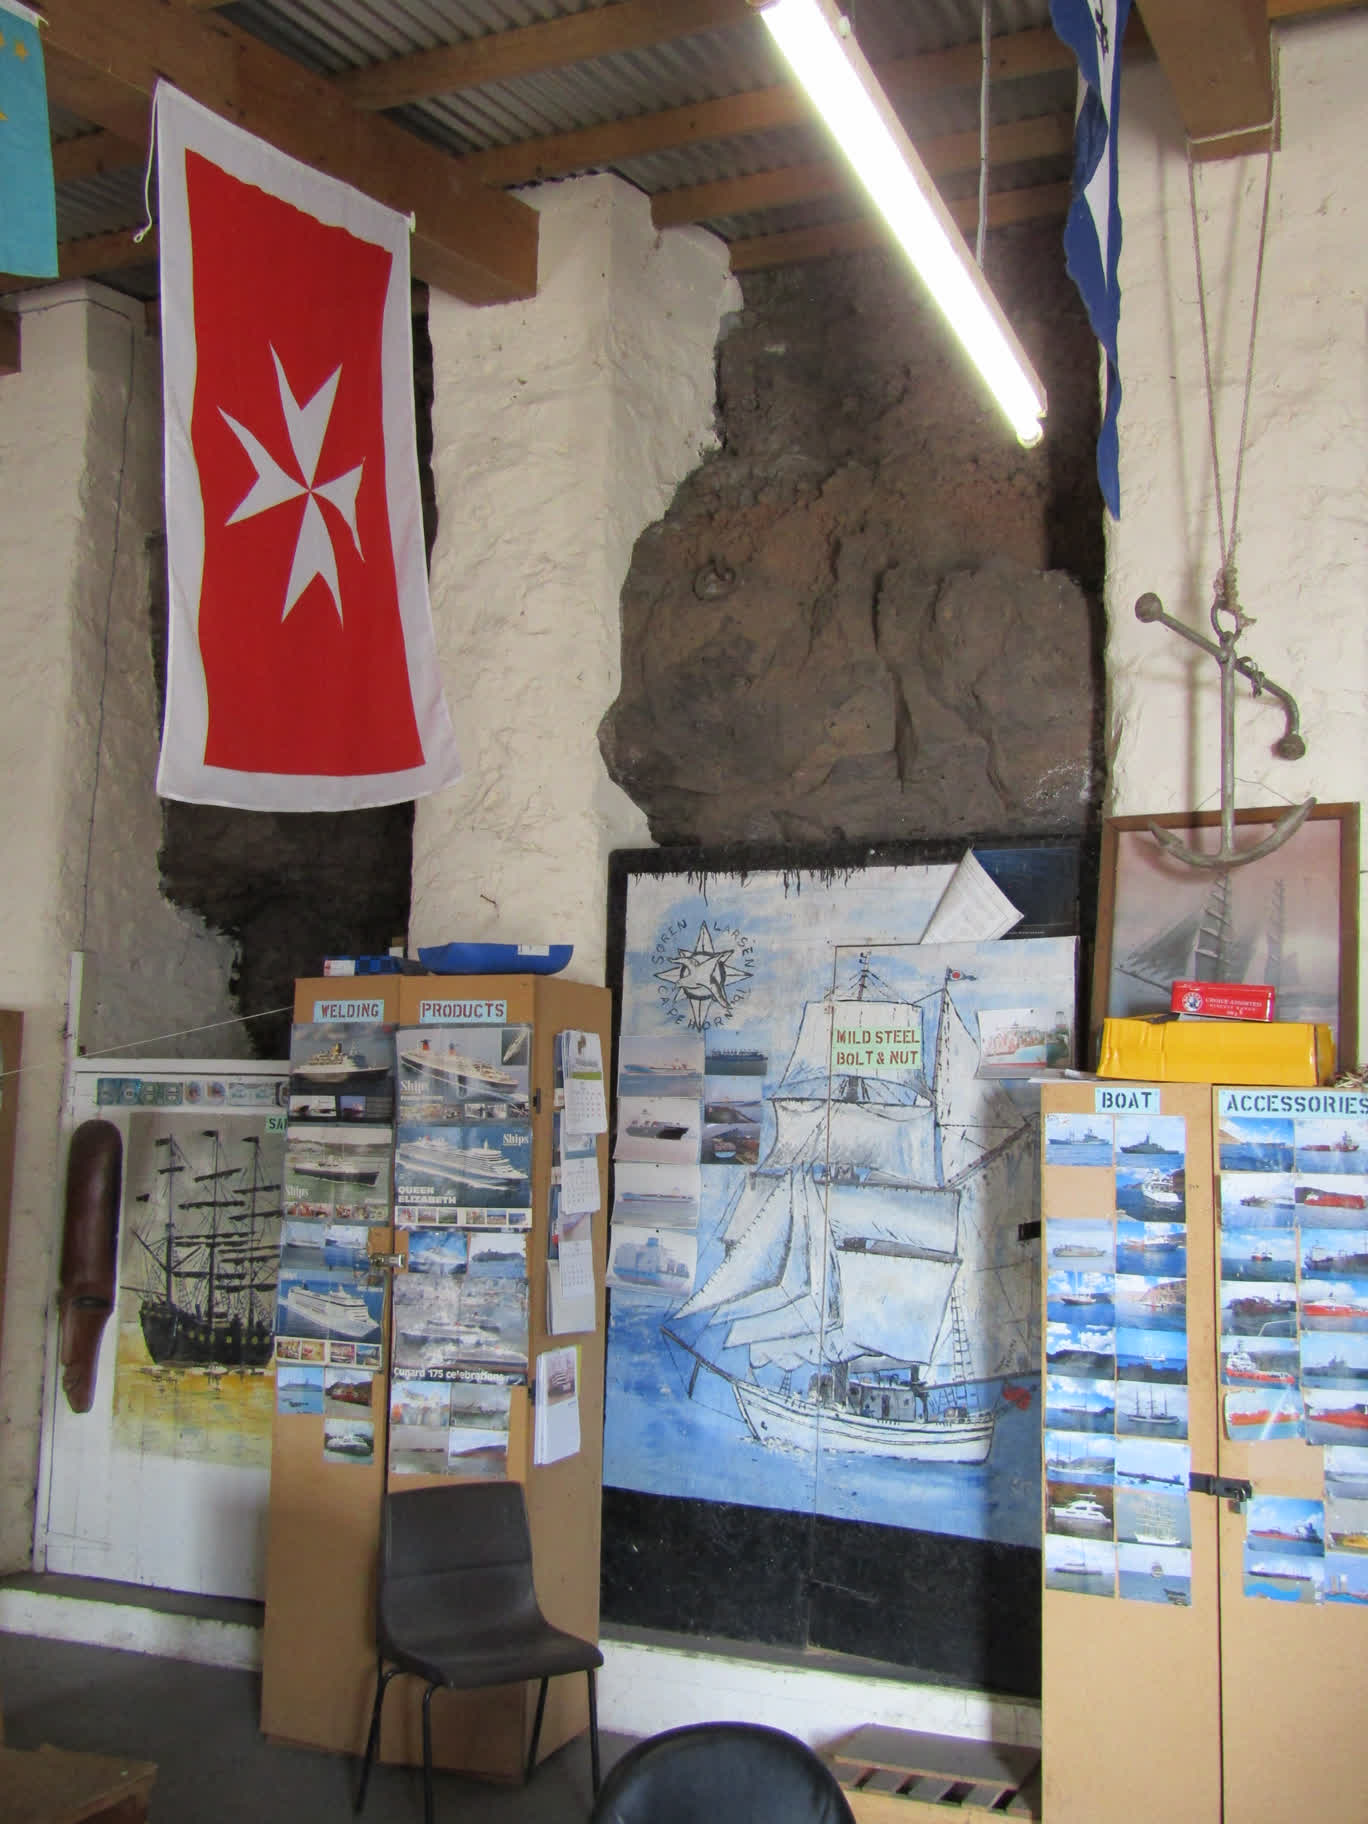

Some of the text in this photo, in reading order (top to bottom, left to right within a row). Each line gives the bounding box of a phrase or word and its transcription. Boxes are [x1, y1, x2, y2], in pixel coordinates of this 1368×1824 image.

[714, 921, 755, 969] LARSEN
[321, 1002, 379, 1018] WELDING
[421, 1001, 505, 1018] PRODUCTS
[658, 985, 685, 1025] CAPE
[688, 1006, 733, 1030] HORN
[836, 1029, 920, 1044] MILD STEEL
[836, 1050, 919, 1065] BOLT & NUT
[1101, 1091, 1152, 1109] BOAT
[1226, 1094, 1368, 1114] ACCESSORIES
[503, 1133, 530, 1146] Ships
[398, 1186, 435, 1195] QUEEN
[398, 1195, 457, 1204] ELIZABETH
[428, 1369, 443, 1378] 175
